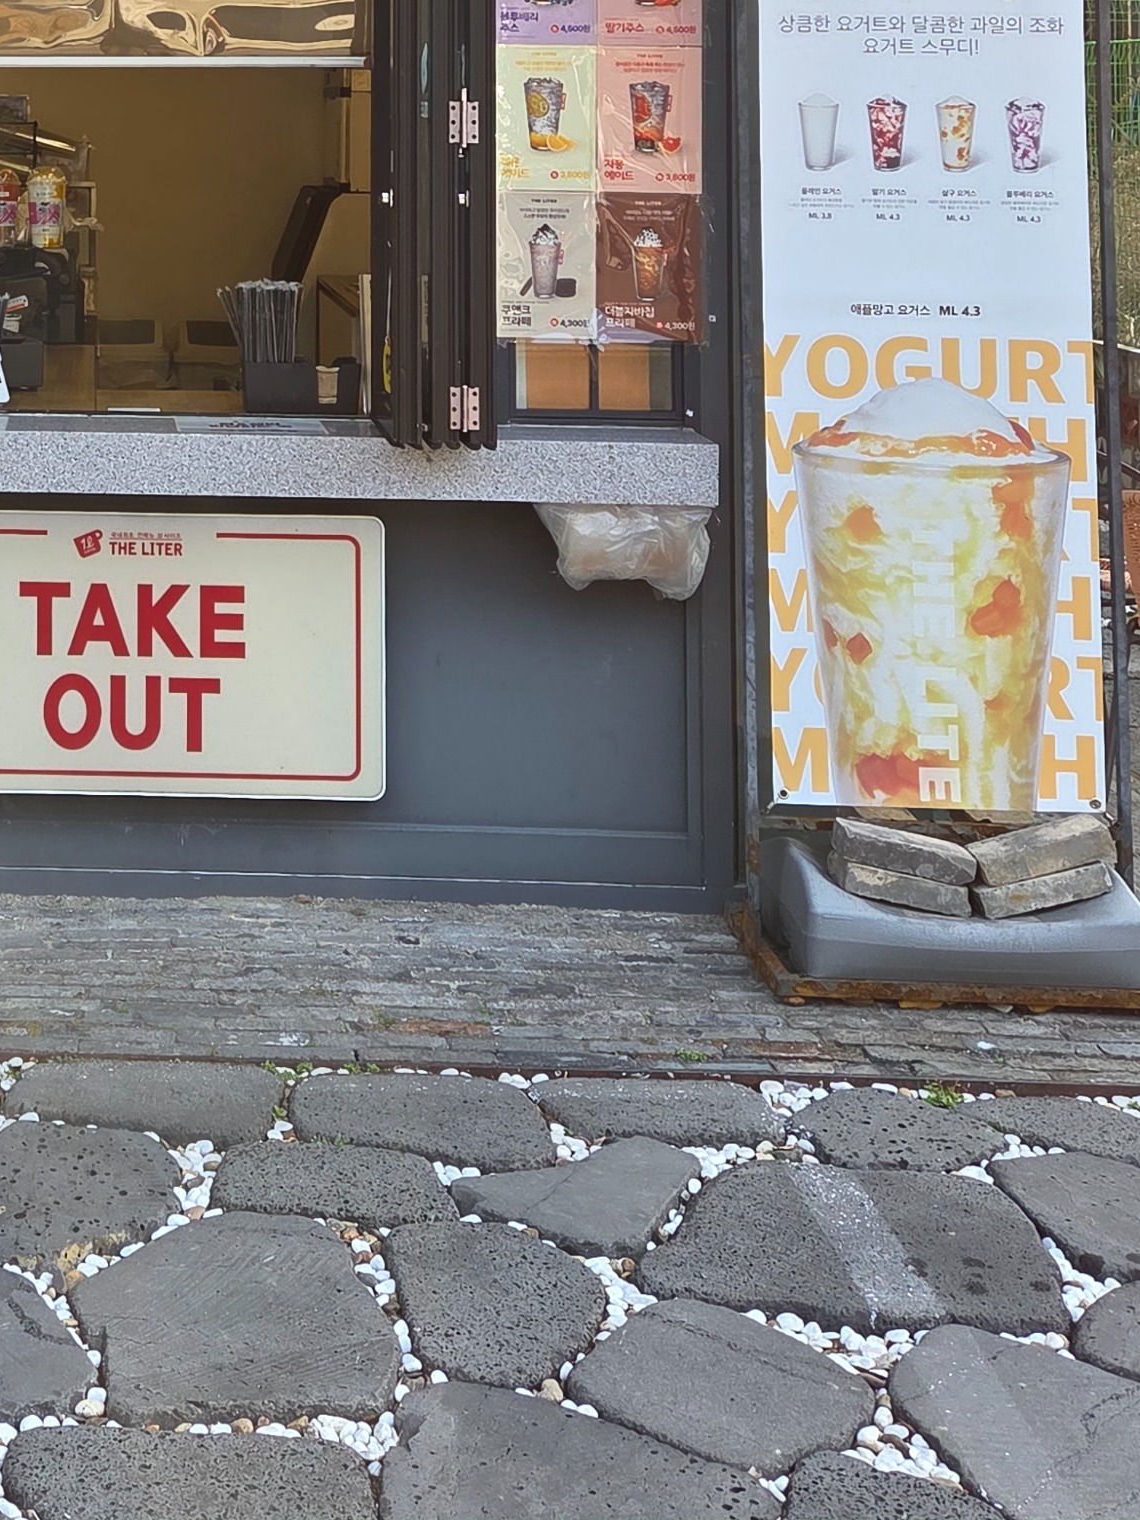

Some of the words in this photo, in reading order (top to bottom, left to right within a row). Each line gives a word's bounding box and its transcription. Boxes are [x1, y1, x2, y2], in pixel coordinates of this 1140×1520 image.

[605, 22, 645, 33] 딸기주스
[779, 15, 831, 33] 상큼한
[836, 16, 906, 33] 요거트와
[912, 16, 965, 34] 달콤한
[970, 16, 1023, 34] 과일의
[1029, 17, 1064, 35] 조화
[862, 38, 915, 55] 요거트
[921, 38, 980, 56] 스무디!
[850, 303, 894, 316] 애플망고
[897, 304, 931, 316] 요거스
[939, 305, 958, 316] ML
[961, 305, 981, 317] 4.3
[109, 542, 137, 555] THE
[142, 542, 183, 556] LITER
[20, 581, 246, 659] TAKE
[43, 673, 221, 752] OUT
